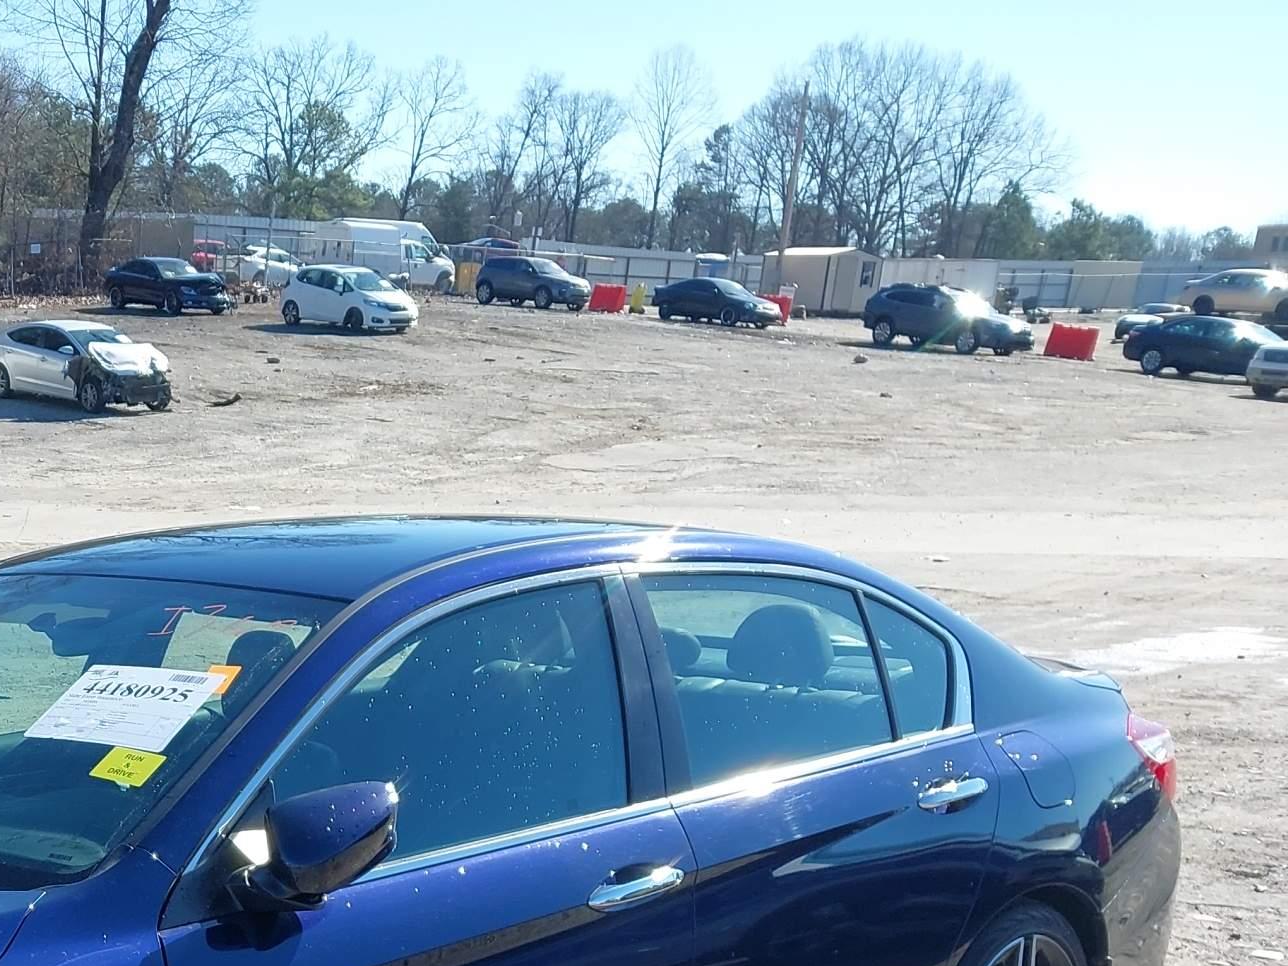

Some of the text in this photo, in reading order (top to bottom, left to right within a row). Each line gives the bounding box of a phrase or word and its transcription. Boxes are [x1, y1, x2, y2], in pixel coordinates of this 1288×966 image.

[83, 681, 194, 703] 44180925
[124, 753, 145, 762] RUN
[107, 767, 136, 779] DRIVE
